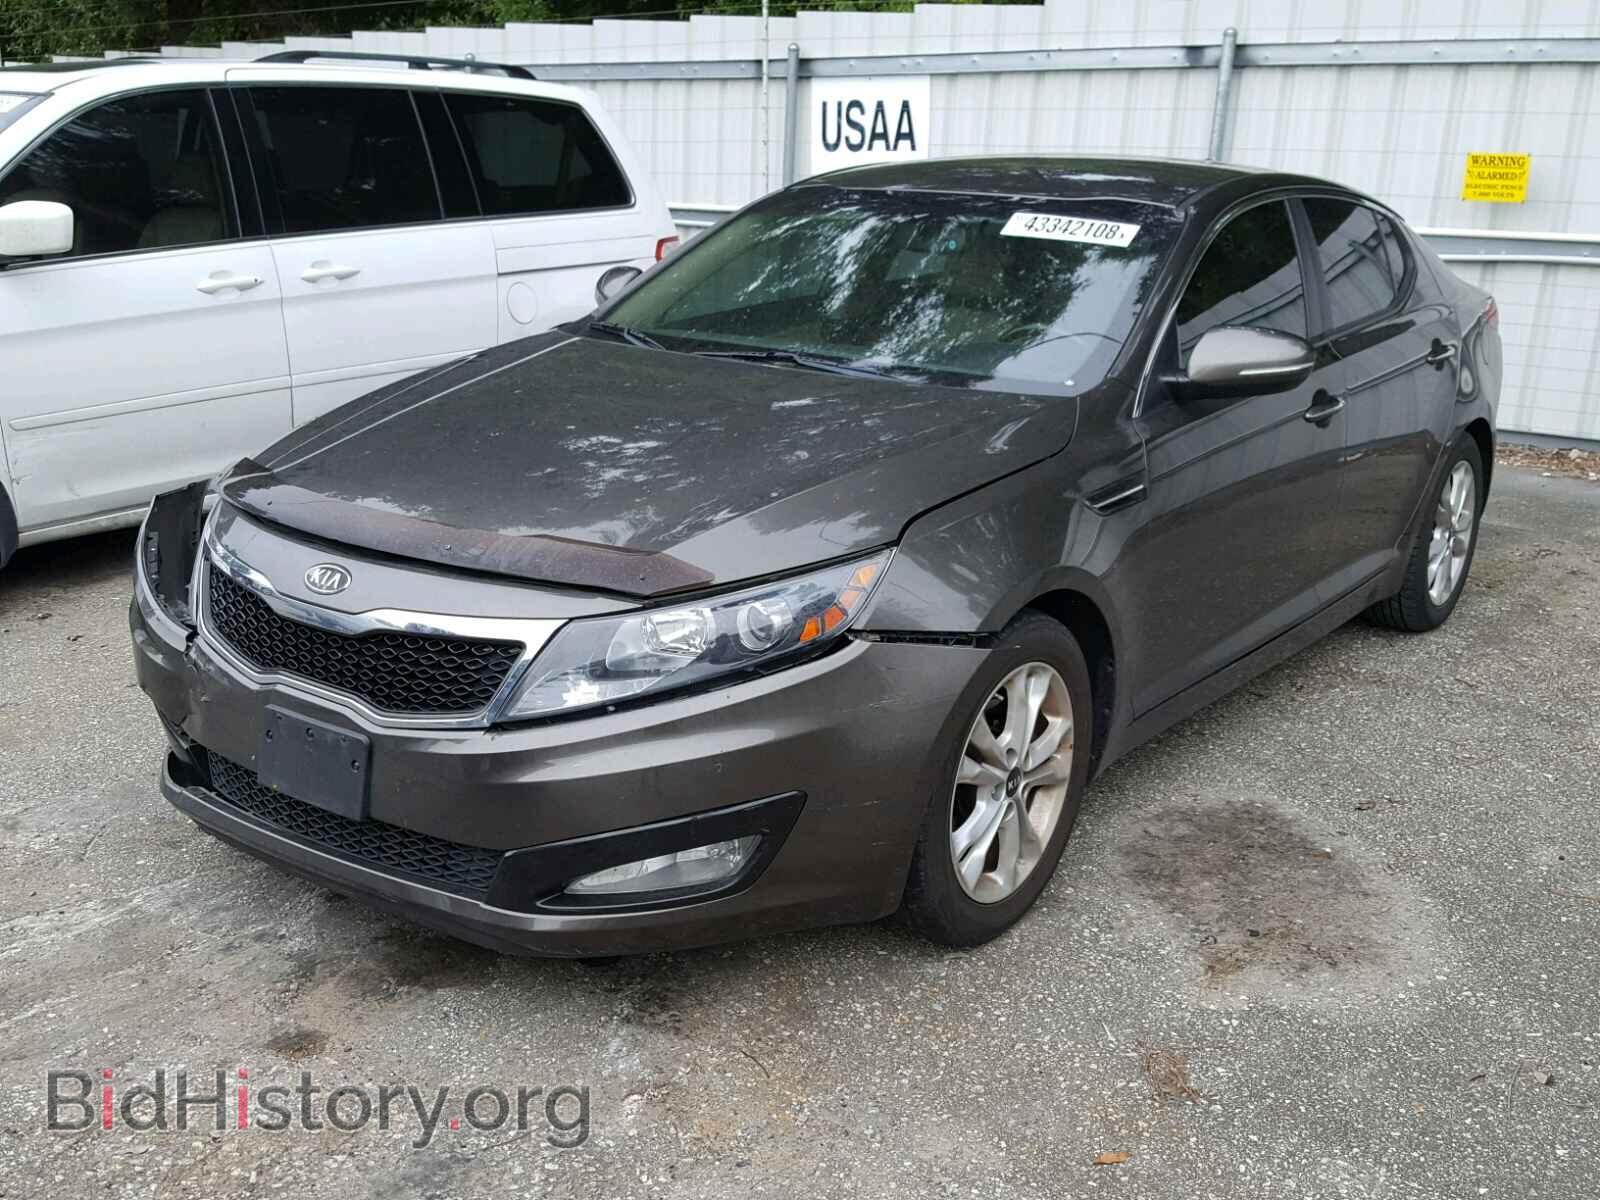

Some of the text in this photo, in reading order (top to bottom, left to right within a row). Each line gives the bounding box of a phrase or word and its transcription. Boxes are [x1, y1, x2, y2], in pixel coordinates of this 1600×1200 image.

[821, 99, 917, 152] USAA
[1471, 155, 1526, 168] WARNING
[1477, 171, 1518, 180] ALARMED
[1024, 216, 1121, 240] 43342108
[310, 568, 341, 589] KIA
